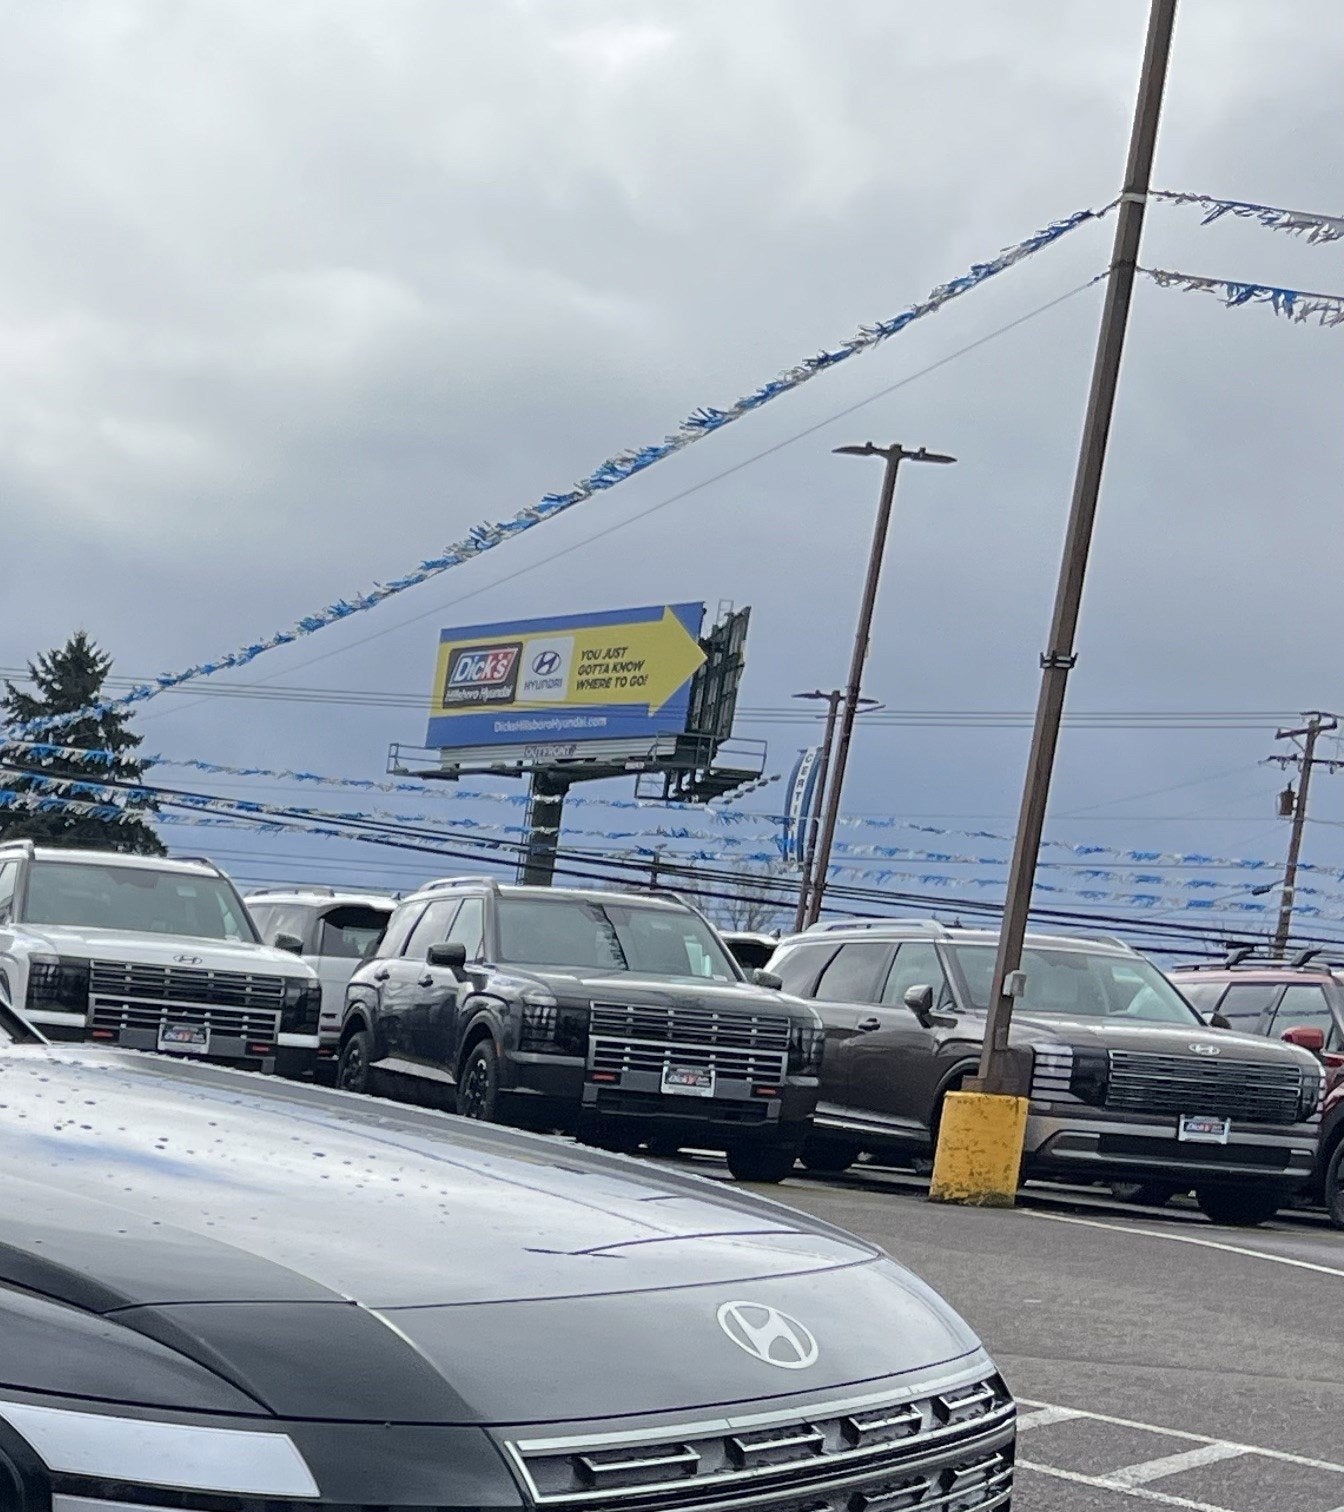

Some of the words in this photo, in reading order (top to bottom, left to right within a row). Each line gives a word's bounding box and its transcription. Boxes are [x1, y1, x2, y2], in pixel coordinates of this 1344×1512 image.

[581, 648, 600, 661] YOU
[602, 646, 628, 660] JUST
[453, 652, 509, 682] Dick's
[578, 662, 610, 676] GOTTA
[612, 659, 646, 674] KNOW
[576, 677, 613, 691] WHERE
[615, 676, 627, 688] TO
